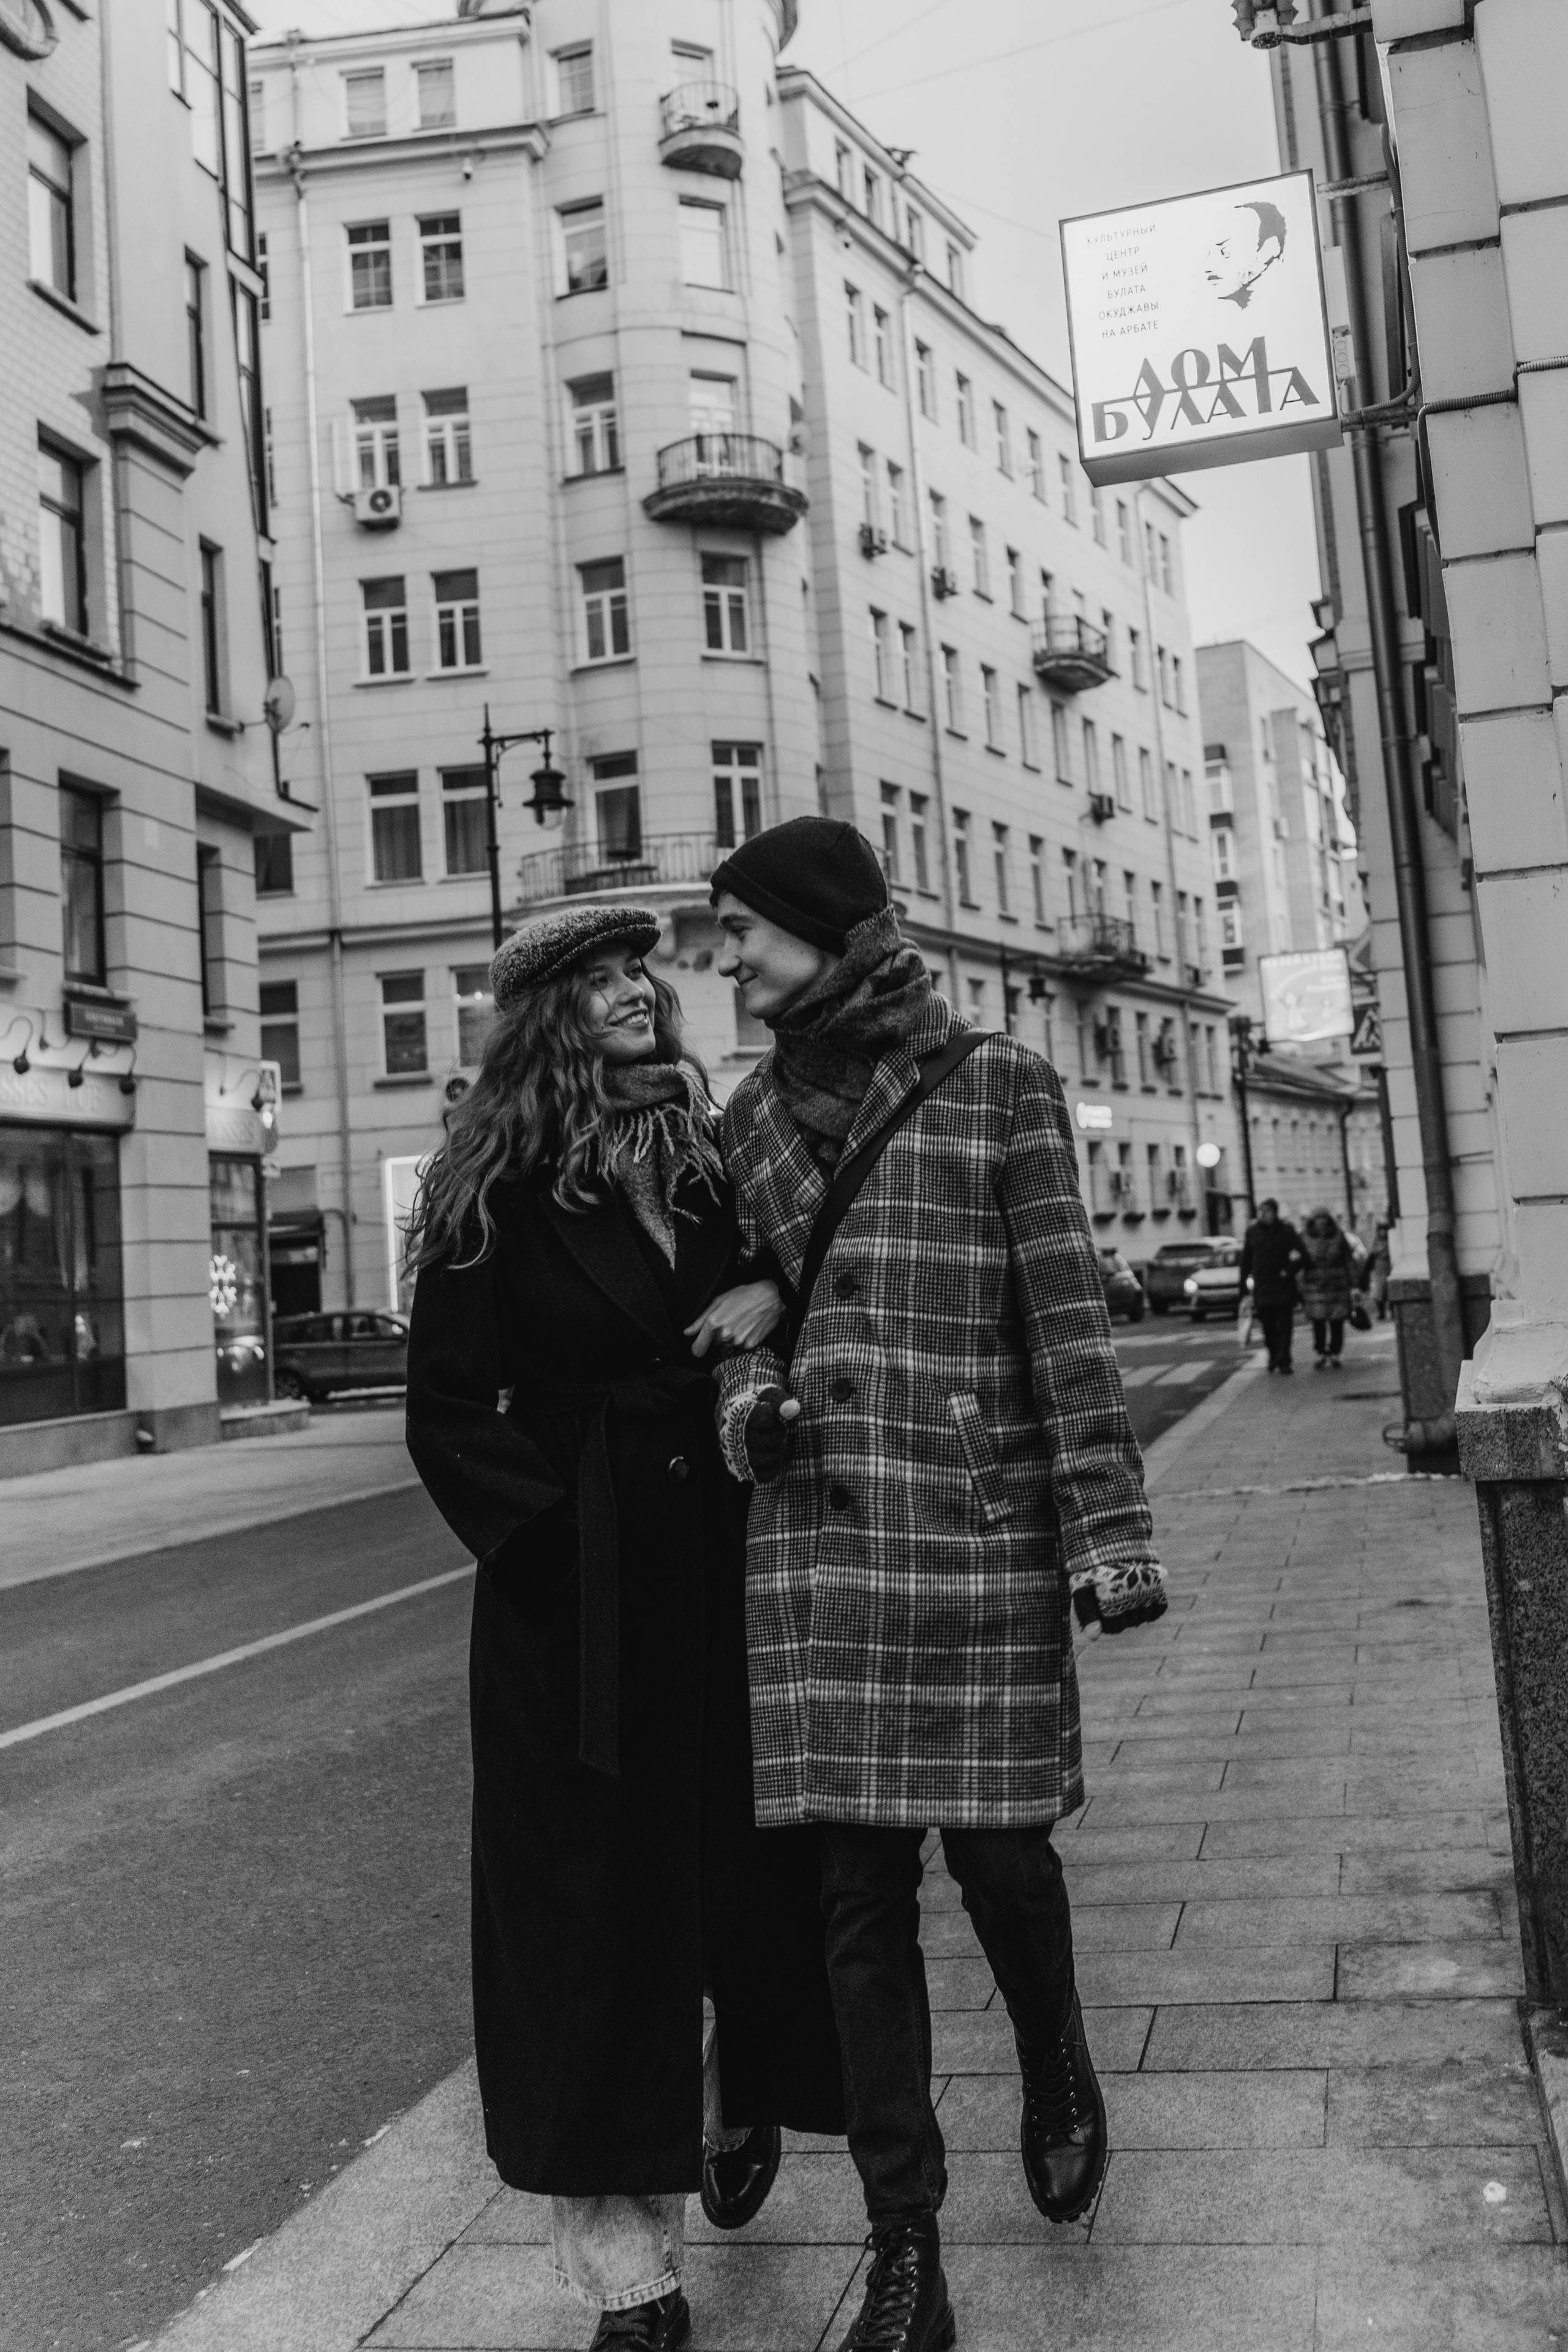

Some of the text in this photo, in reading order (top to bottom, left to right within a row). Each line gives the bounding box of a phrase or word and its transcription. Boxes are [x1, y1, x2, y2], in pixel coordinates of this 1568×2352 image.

[1087, 222, 1156, 245] КУЛЬТУРНЫЙ
[1106, 246, 1140, 262] ЦЕНТР
[1102, 262, 1148, 281] И МУЗЕЙ
[1107, 284, 1147, 299] БУЛАТА
[1098, 301, 1159, 320] ОКУДЖАВЫ
[1102, 320, 1159, 339] НА АРБАТЕ
[1132, 335, 1269, 399] ДОМ
[1091, 366, 1321, 443] БУЛАТА
